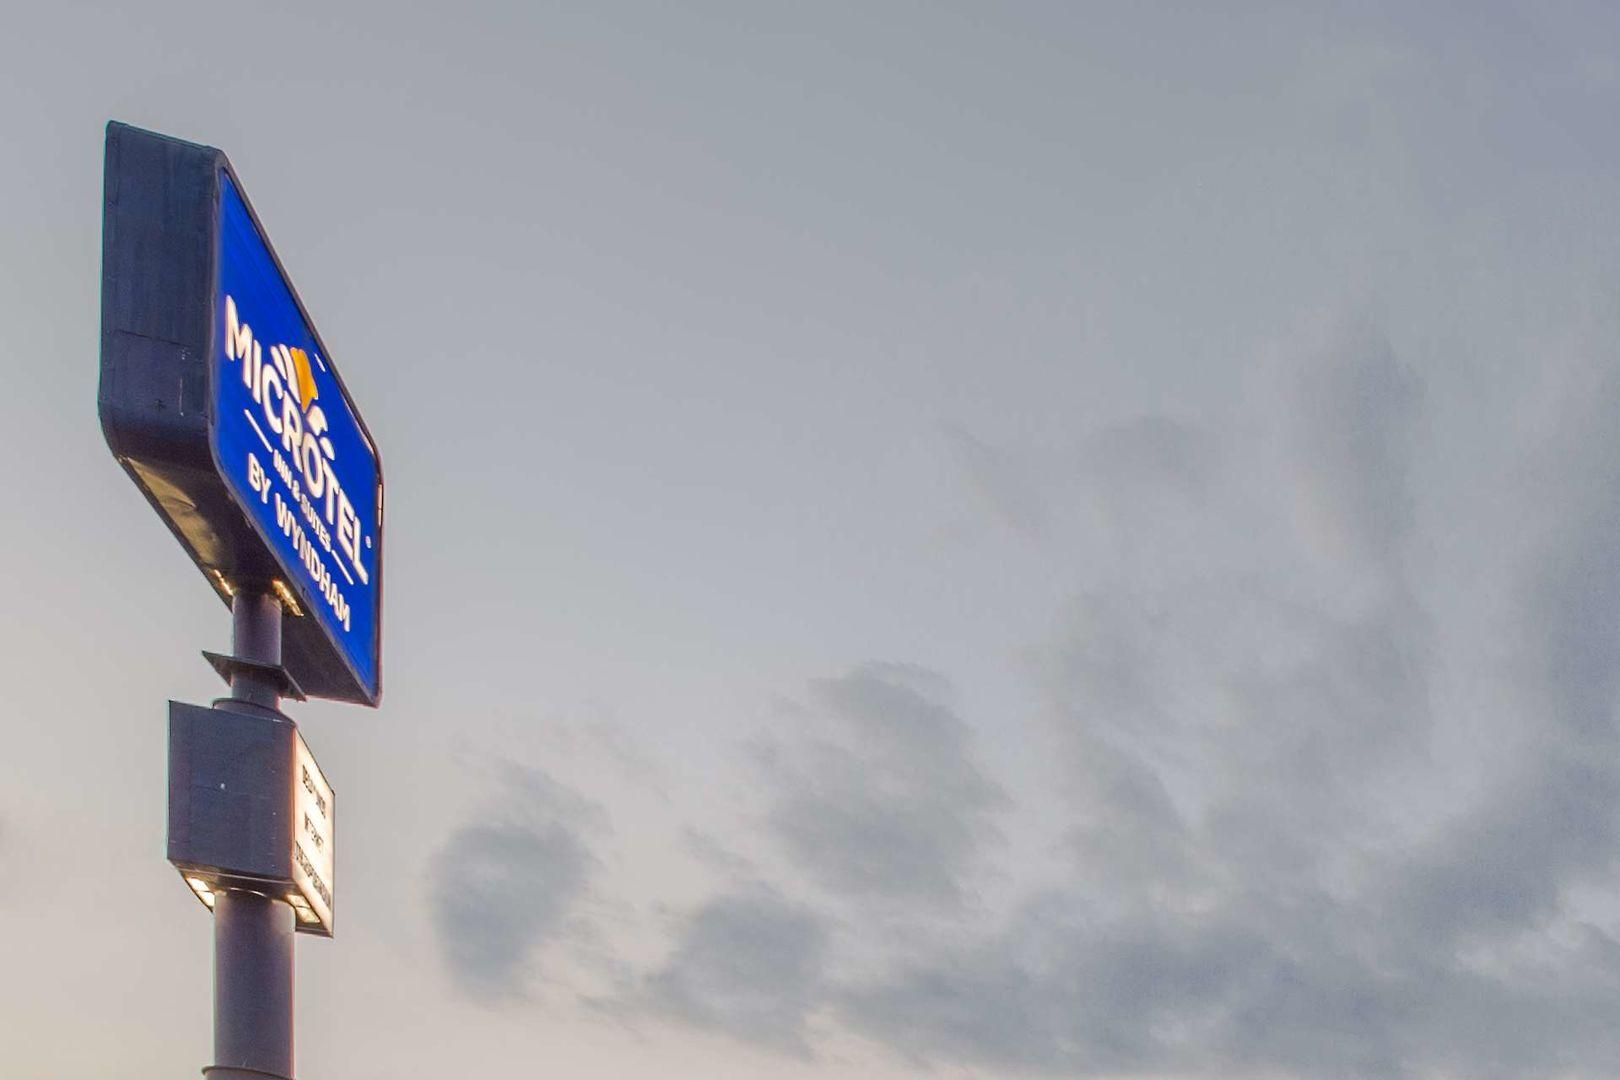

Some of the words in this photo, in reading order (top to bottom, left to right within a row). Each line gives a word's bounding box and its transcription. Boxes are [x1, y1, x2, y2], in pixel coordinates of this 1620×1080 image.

[225, 295, 368, 585] MICROTEL
[248, 453, 271, 504] BY
[275, 493, 350, 632] WYNDHAM
